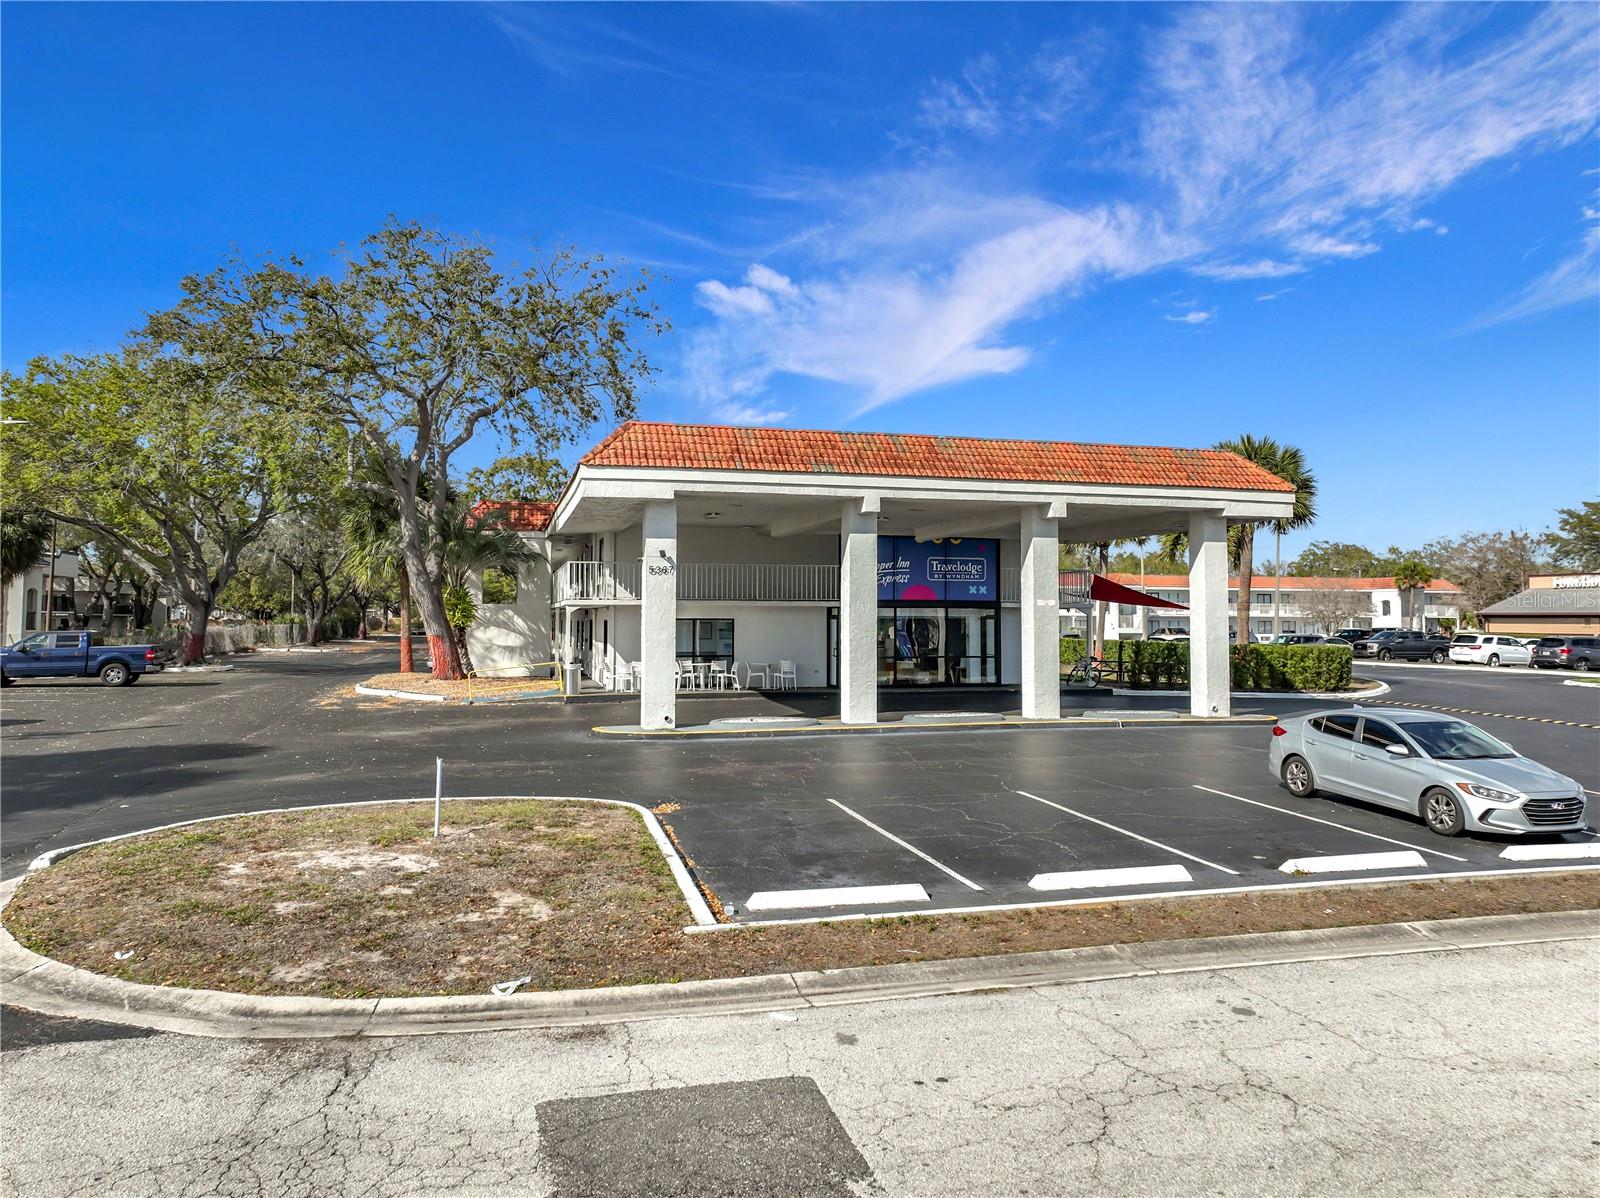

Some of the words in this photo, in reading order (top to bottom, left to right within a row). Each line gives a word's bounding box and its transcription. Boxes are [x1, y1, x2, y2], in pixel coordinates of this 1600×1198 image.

[896, 556, 910, 568] Inn
[930, 561, 982, 575] Travelodge
[877, 573, 910, 587] Express
